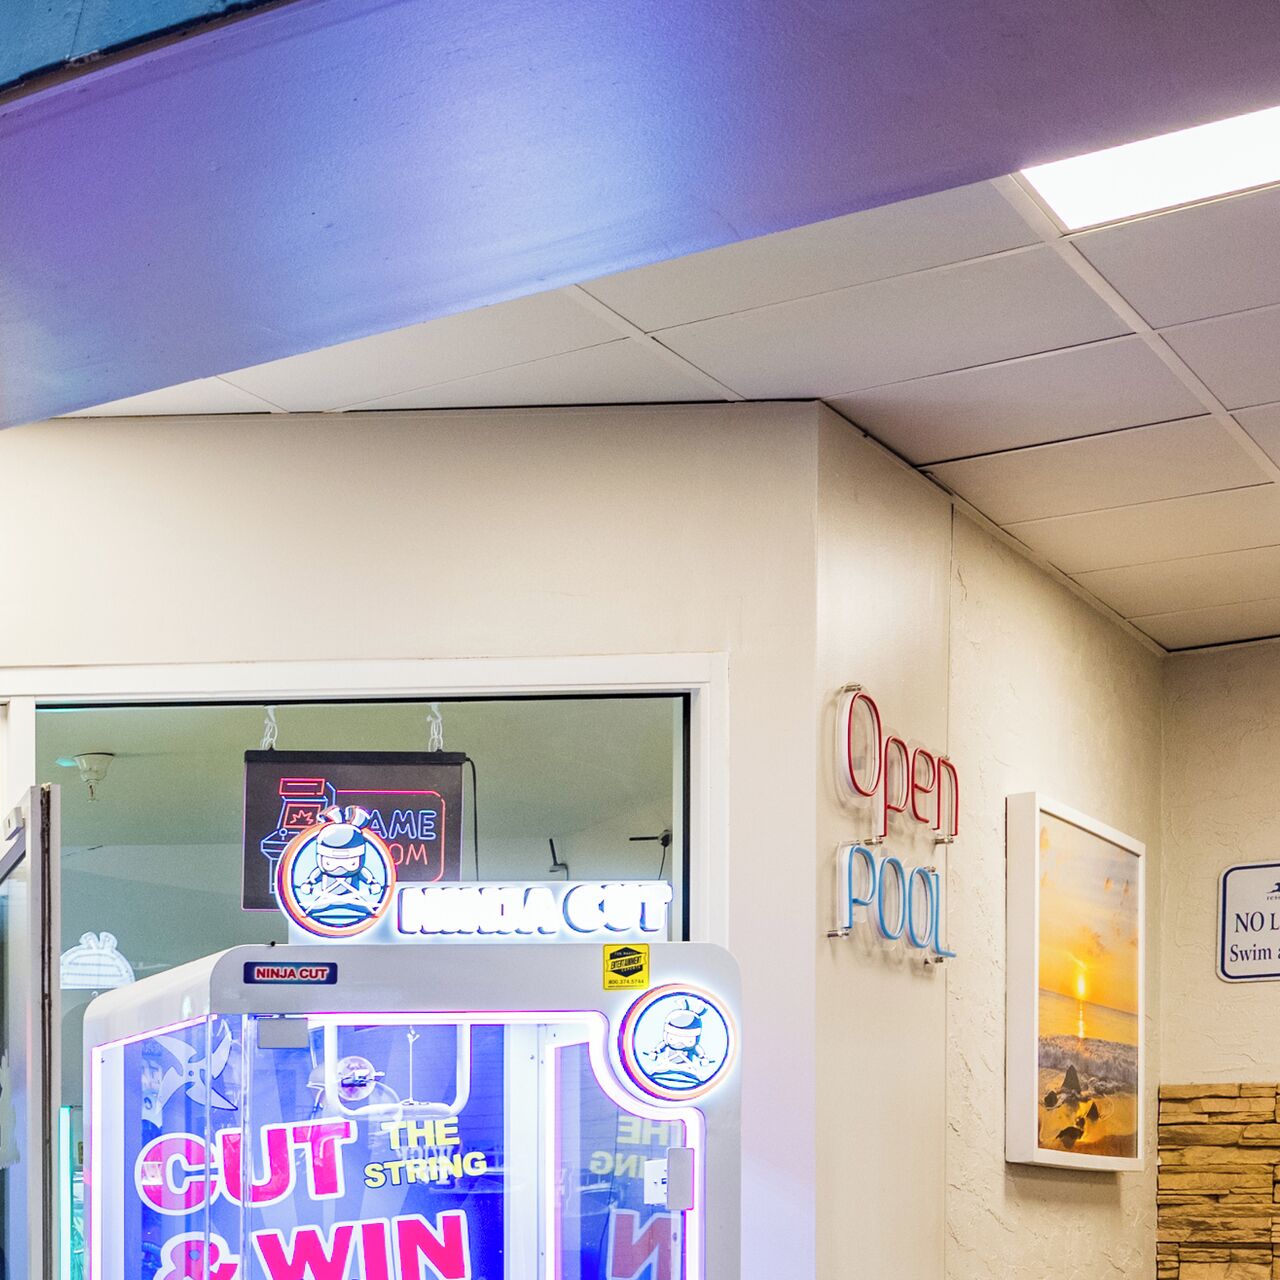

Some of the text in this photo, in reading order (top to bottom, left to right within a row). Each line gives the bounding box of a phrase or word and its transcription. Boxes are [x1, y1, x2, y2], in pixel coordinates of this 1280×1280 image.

[848, 692, 958, 836] Open
[369, 810, 438, 840] AME
[389, 843, 428, 866] OM
[563, 884, 674, 932] CUT
[1235, 911, 1265, 933] NO
[1229, 943, 1272, 963] Swim
[255, 967, 328, 979] NINJA CUT
[134, 1116, 460, 1217] CUT THE
[364, 1150, 487, 1188] STRING
